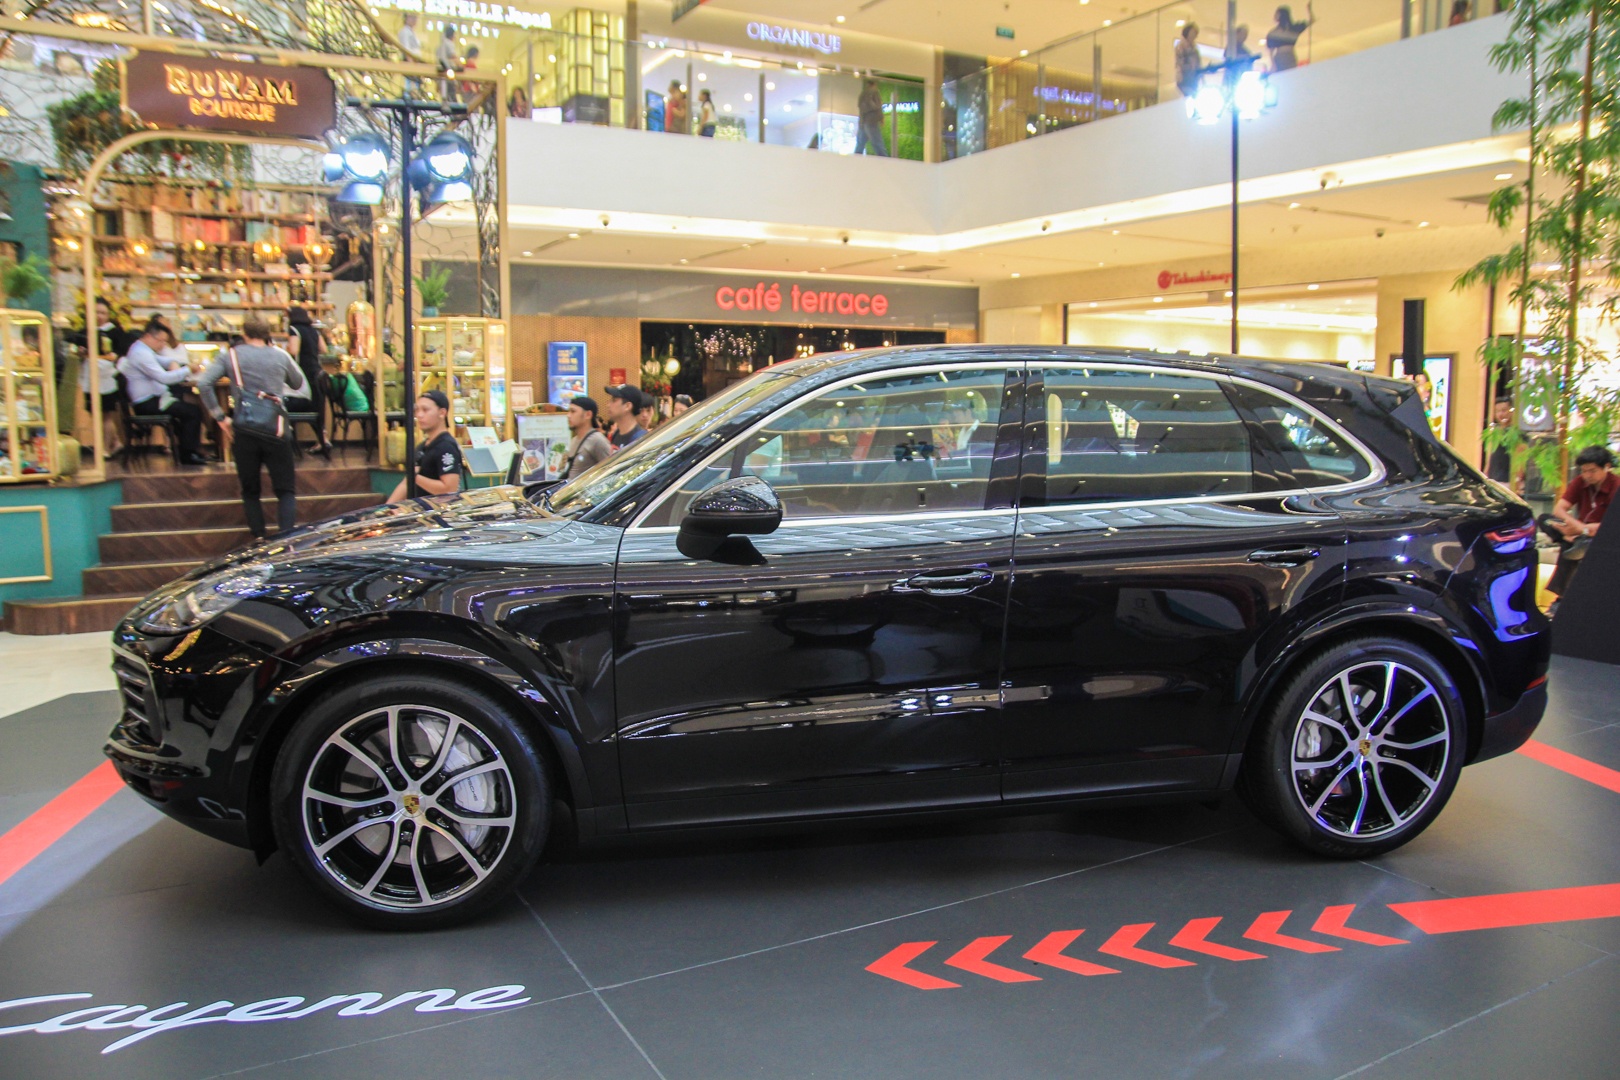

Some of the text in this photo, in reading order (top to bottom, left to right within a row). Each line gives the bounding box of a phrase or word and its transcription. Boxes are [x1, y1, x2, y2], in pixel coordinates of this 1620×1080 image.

[747, 22, 841, 54] ORGANIQUE
[189, 97, 276, 123] BOUTIQUE
[716, 281, 889, 316] café terrace
[0, 985, 532, 1054] Cayenne
